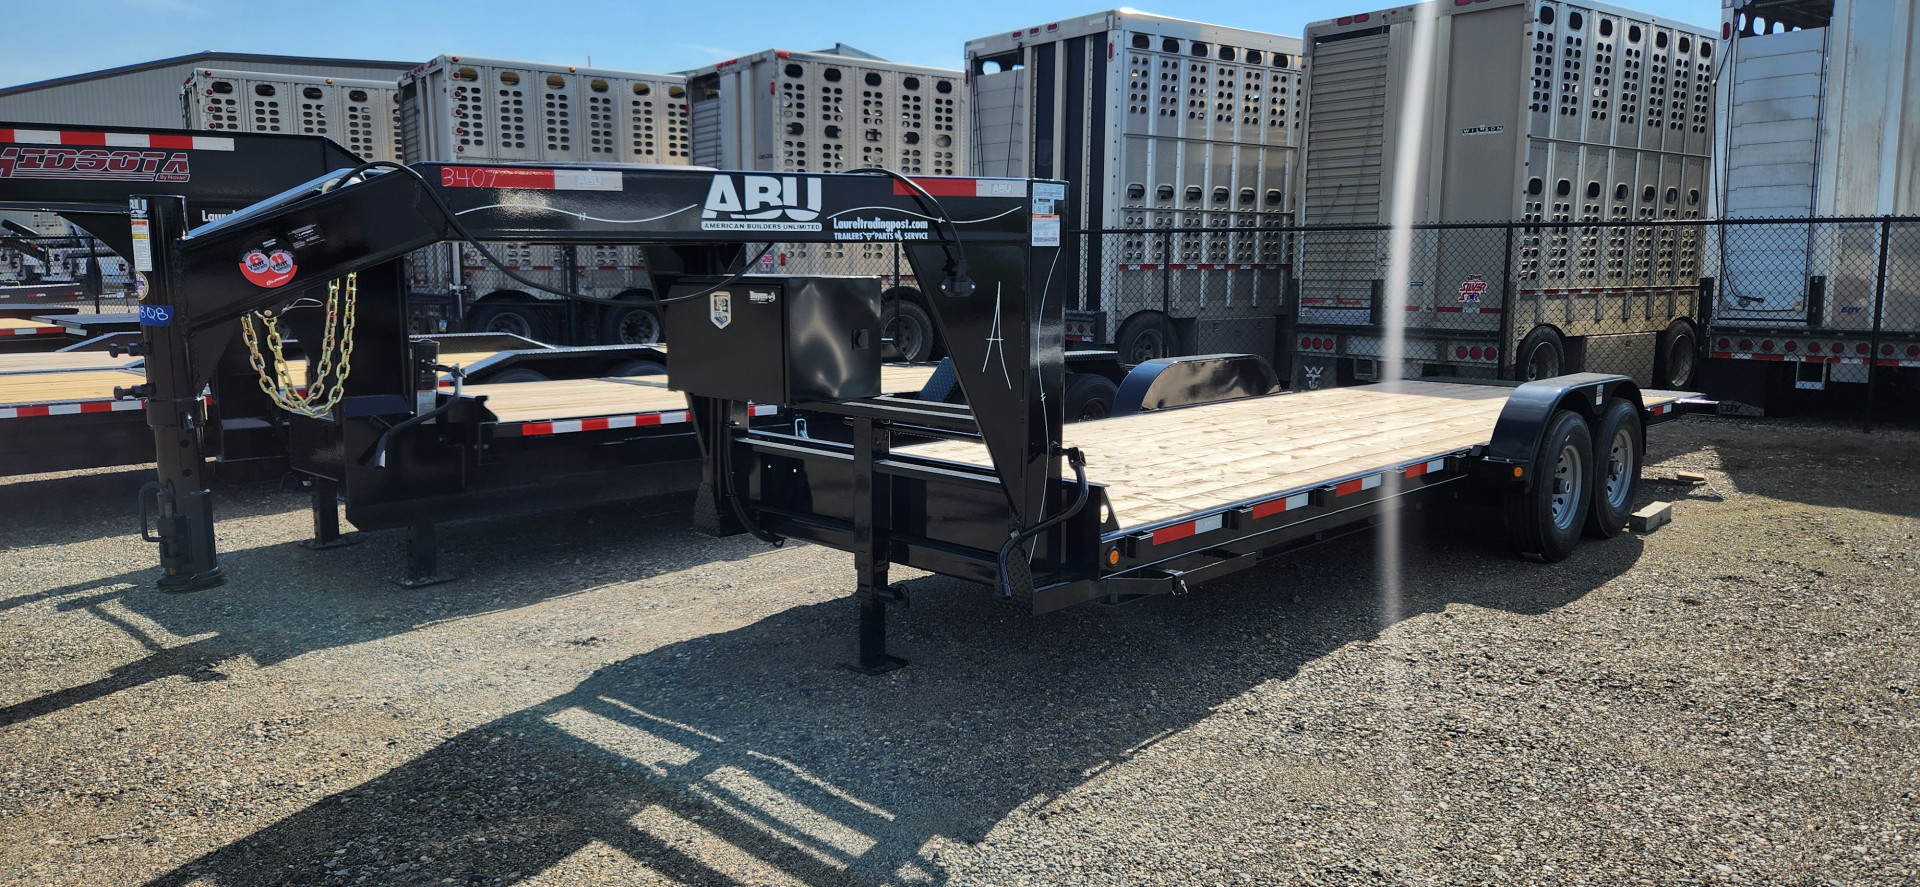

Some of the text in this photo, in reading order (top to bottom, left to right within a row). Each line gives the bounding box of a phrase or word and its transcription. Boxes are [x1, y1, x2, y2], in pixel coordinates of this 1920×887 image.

[442, 168, 498, 188] 3407
[702, 174, 822, 221] ABU
[704, 222, 745, 230] AMERICAN
[833, 216, 929, 232] Laureltradingpost.com
[833, 232, 929, 240] TRAILERS PARTS SERVICE
[249, 254, 262, 265] 6
[1459, 282, 1488, 293] SILVER
